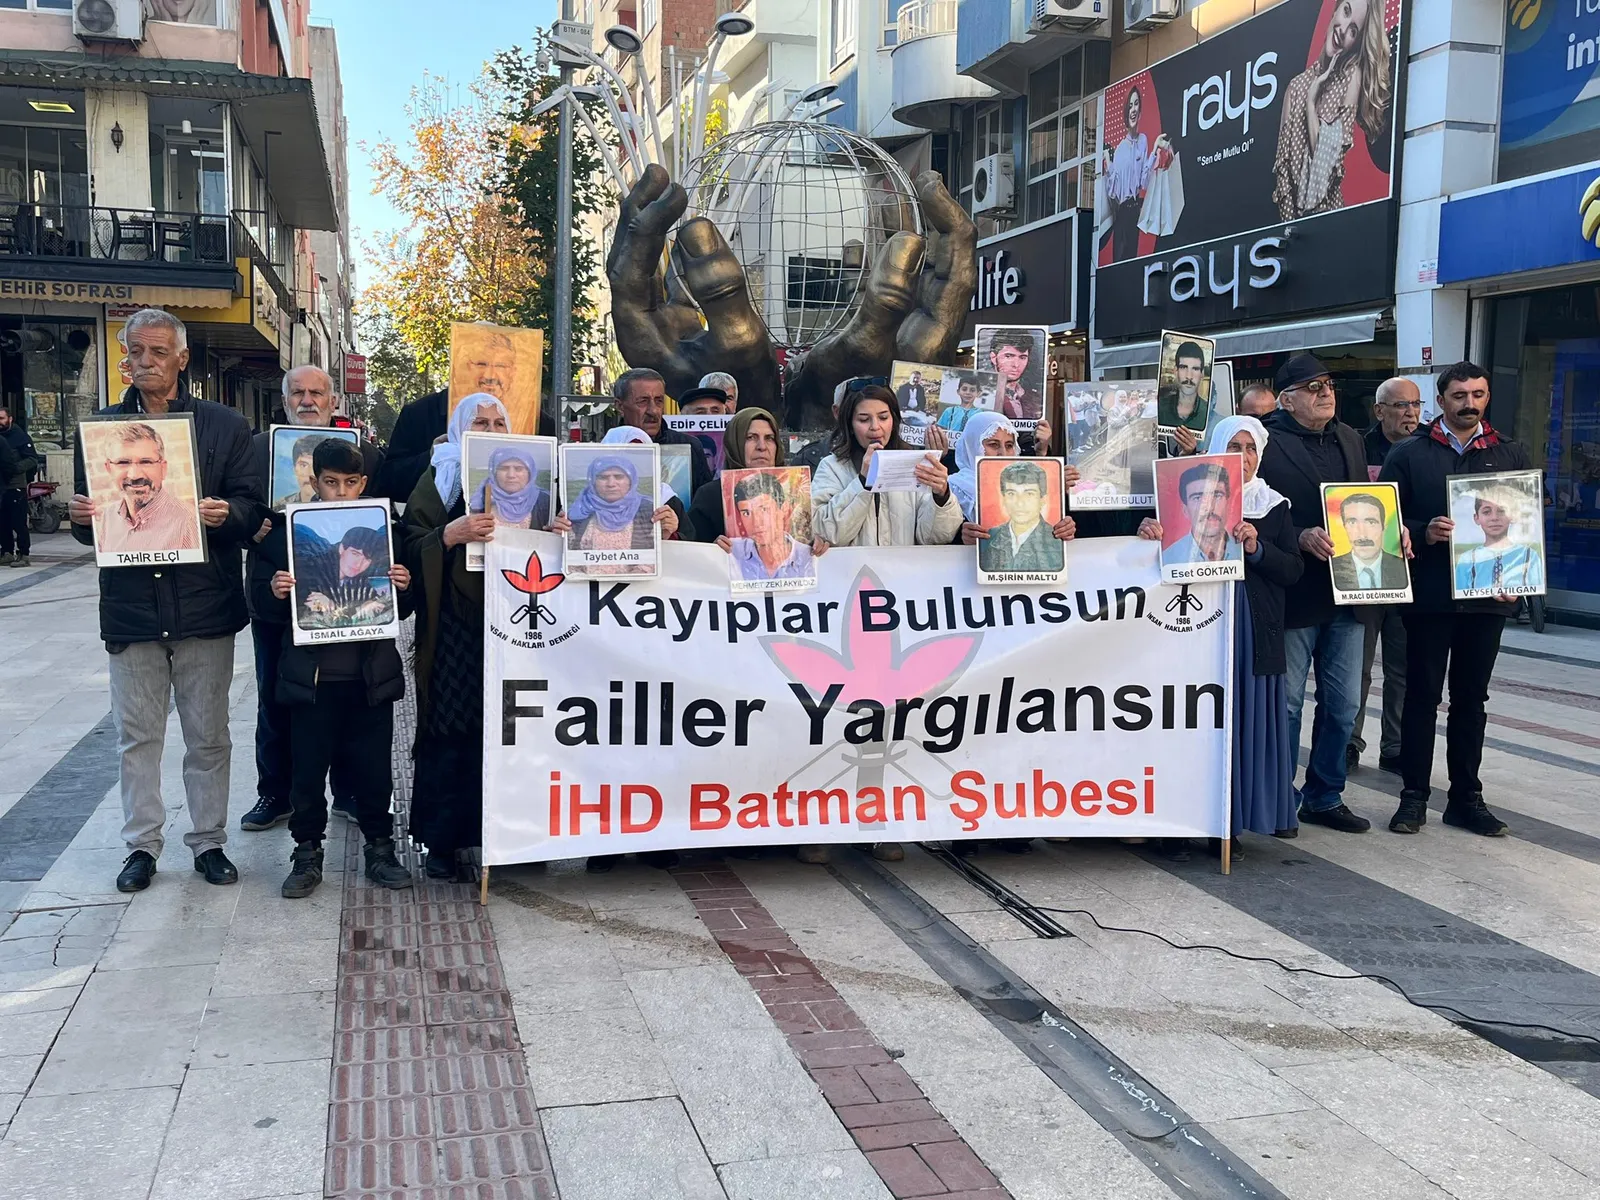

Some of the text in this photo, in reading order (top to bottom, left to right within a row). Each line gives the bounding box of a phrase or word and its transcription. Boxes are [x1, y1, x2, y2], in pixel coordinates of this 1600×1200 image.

[1566, 29, 1600, 71] int
[1181, 51, 1278, 137] rays
[1214, 152, 1222, 162] de
[1223, 145, 1241, 159] Mutlu
[1143, 237, 1282, 310] rays
[1, 281, 133, 299] EHİR SOFRASI
[671, 419, 696, 429] EDİP
[1077, 496, 1153, 504] MERYEM BULUT
[117, 550, 180, 563] TAHİR ELÇİ
[584, 552, 640, 562] Taybet Ana
[988, 573, 1024, 582] M.ŞİRİN
[1171, 566, 1237, 578] Eset GÖKTAYI
[732, 581, 764, 589] MEHMET
[765, 580, 783, 589] ZEKİ
[1366, 590, 1406, 600] DEĞİRMENCİ
[1463, 586, 1537, 597] VEYSEL ATILGAN
[589, 581, 1145, 644] Kayıplar Bulunsun
[1146, 608, 1224, 632] İNSAN HAKLARI DERNEĞİ
[1175, 617, 1191, 625] 1986
[311, 627, 384, 639] İSMAİL AĞAYA
[511, 638, 545, 649] HAKLARI
[549, 623, 581, 647] DERNEĞİ
[524, 631, 543, 640] 1986
[502, 676, 1224, 753] Failler Yargılansın
[549, 766, 1154, 836] İHD Batman Şubesi
